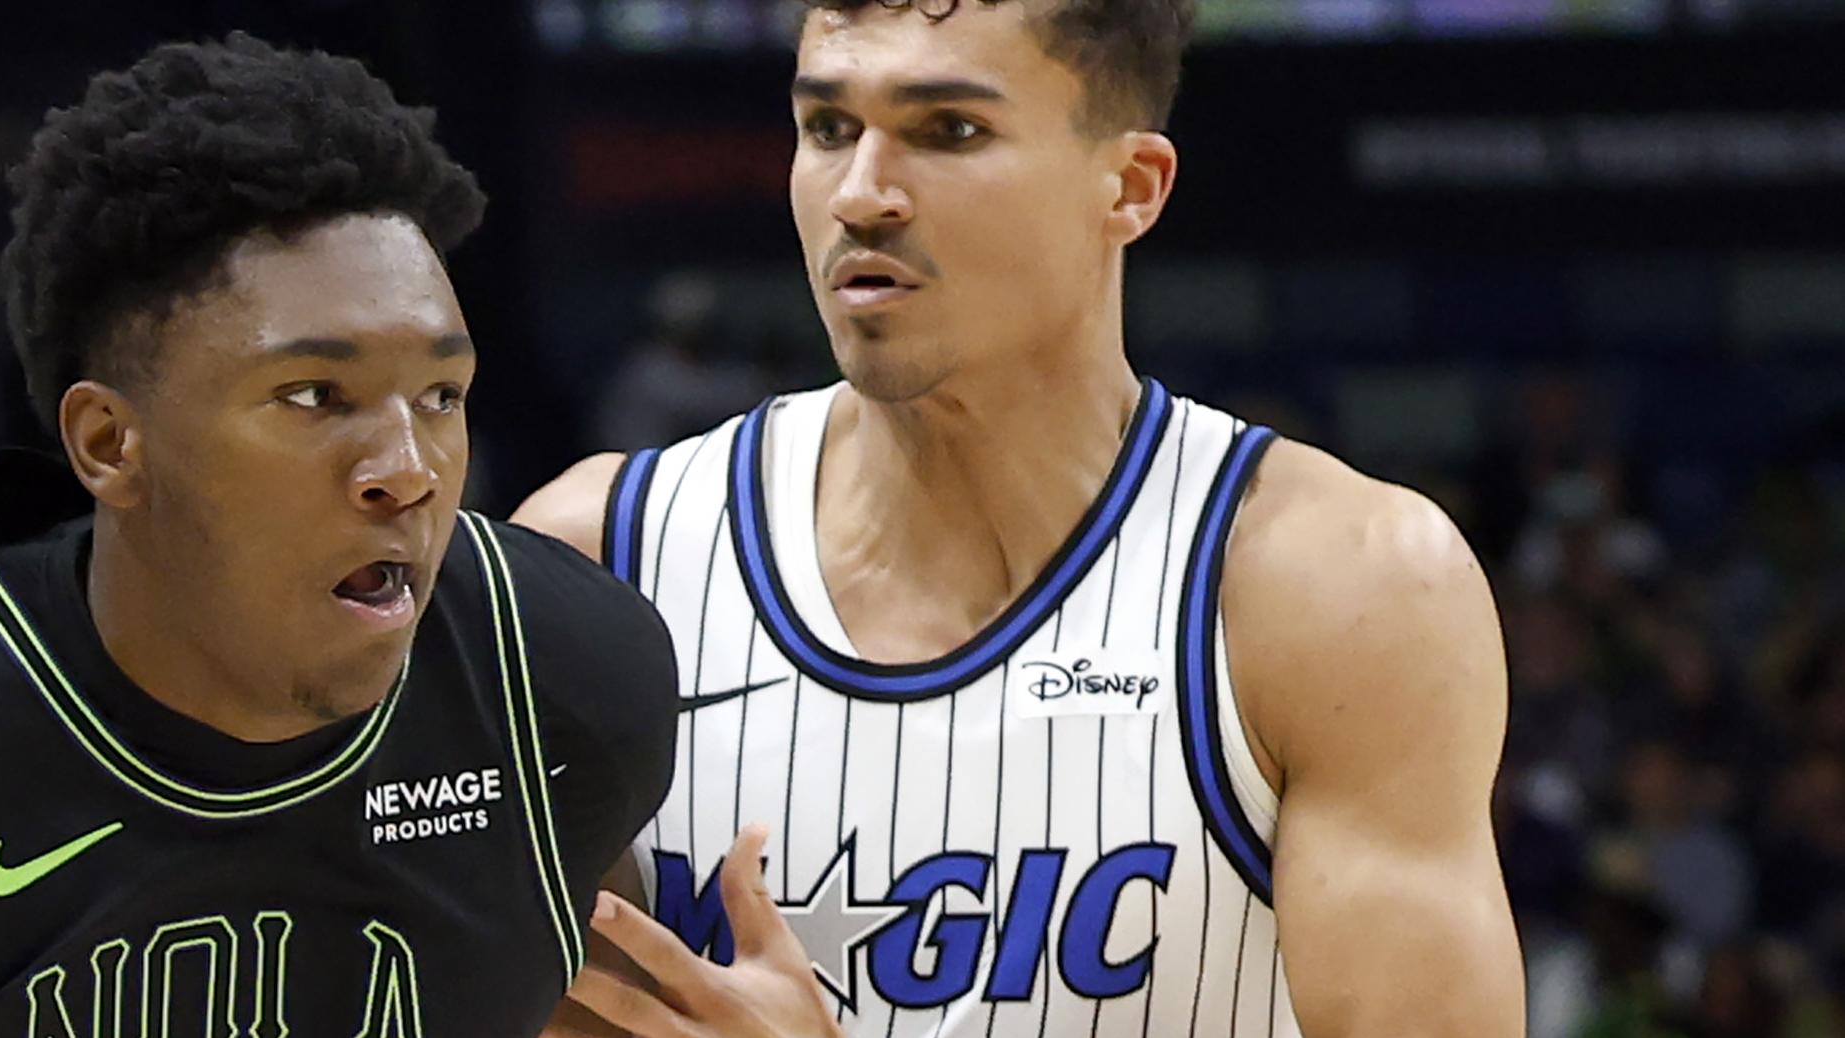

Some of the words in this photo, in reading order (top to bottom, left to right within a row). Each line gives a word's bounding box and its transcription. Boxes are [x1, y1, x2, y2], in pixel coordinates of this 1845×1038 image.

[1021, 657, 1160, 711] Disney
[363, 767, 502, 821] NEWAGE
[372, 808, 489, 845] PRODUCTS
